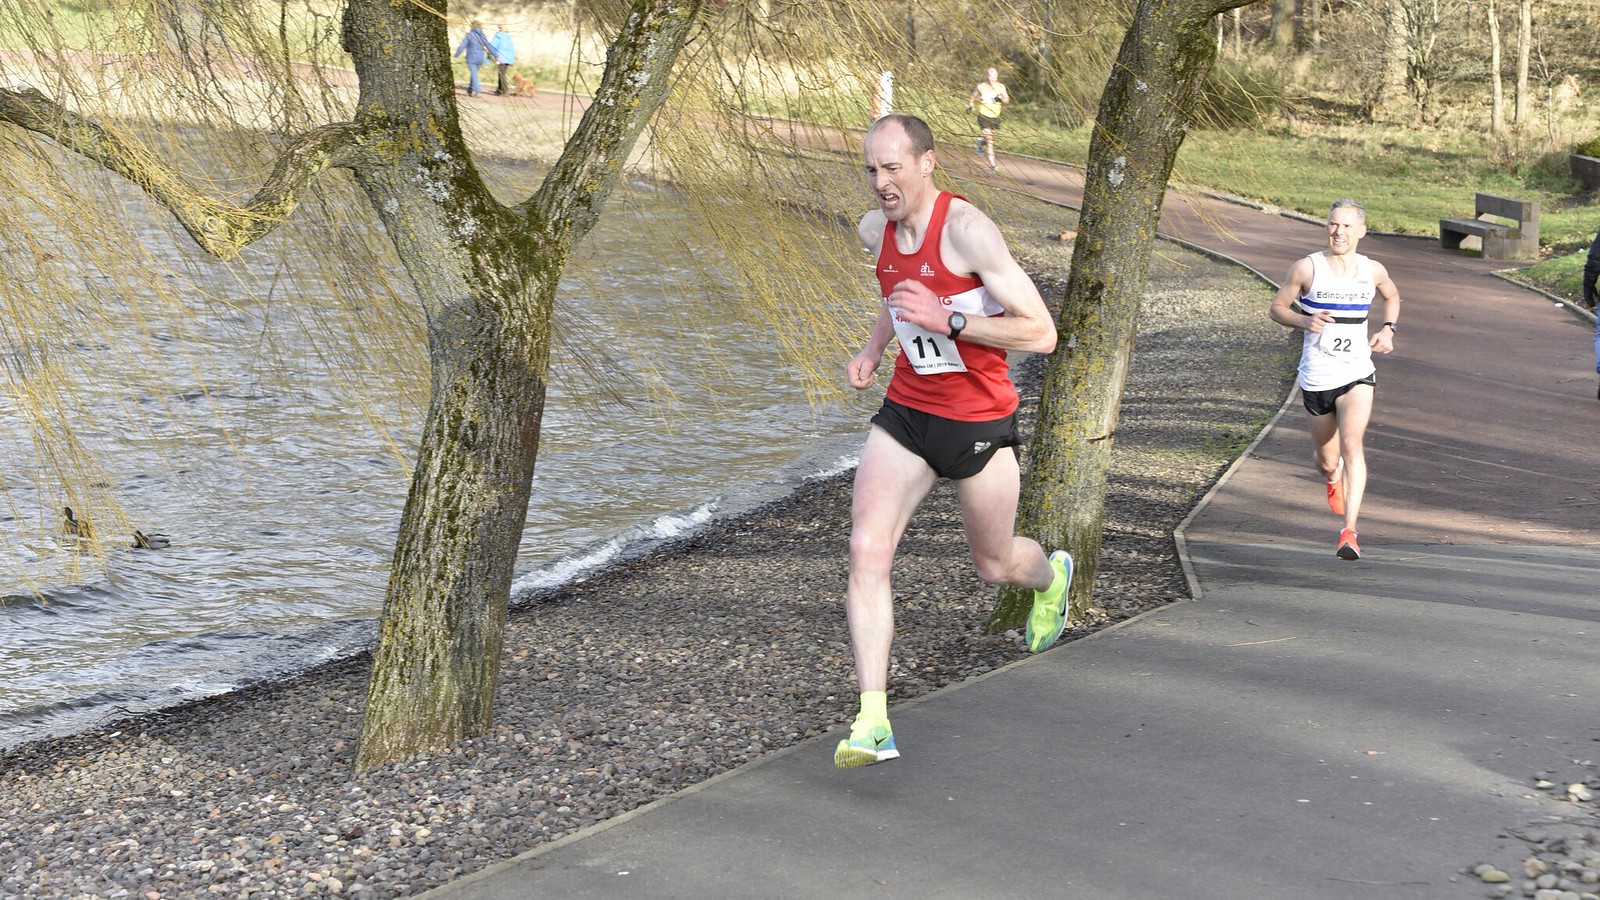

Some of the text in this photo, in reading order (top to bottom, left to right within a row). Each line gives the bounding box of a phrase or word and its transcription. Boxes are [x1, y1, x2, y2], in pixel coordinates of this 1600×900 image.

[1316, 291, 1358, 301] Edinburgh
[912, 335, 942, 359] 11
[1333, 338, 1352, 352] 22
